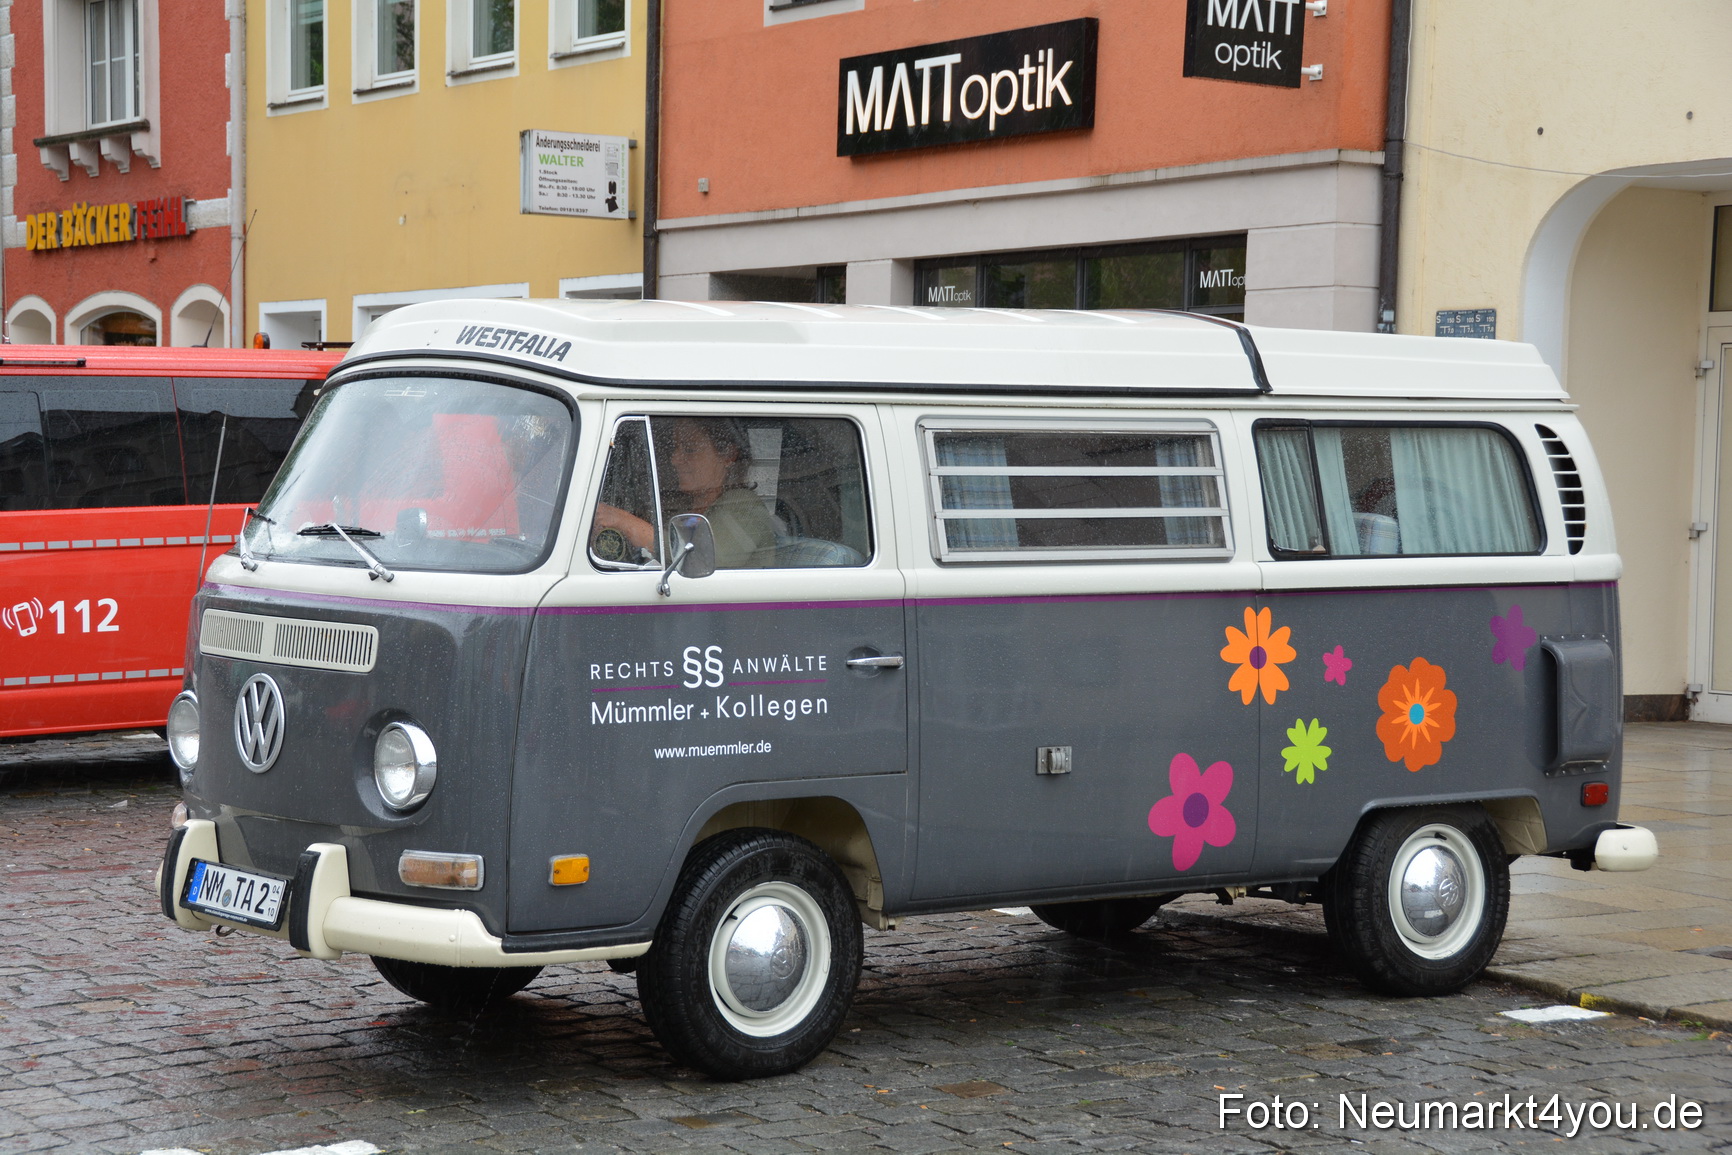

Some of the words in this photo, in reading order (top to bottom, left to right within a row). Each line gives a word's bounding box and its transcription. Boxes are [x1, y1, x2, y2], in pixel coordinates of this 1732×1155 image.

[1206, 0, 1300, 35] MATT
[1215, 41, 1282, 72] optik
[536, 132, 600, 152] Änderungsschneiderei
[538, 153, 584, 167] WALTER
[26, 211, 59, 251] DER
[62, 201, 132, 248] BÄCKER
[456, 325, 572, 362] WESTFALIA
[48, 598, 120, 634] 112
[590, 661, 674, 680] RECHTS
[732, 655, 827, 675] ANWÄLTE
[591, 698, 694, 725] Mümmler
[716, 694, 828, 720] Kollegen
[654, 740, 772, 759] www.muemmler.de
[199, 868, 226, 904] NM
